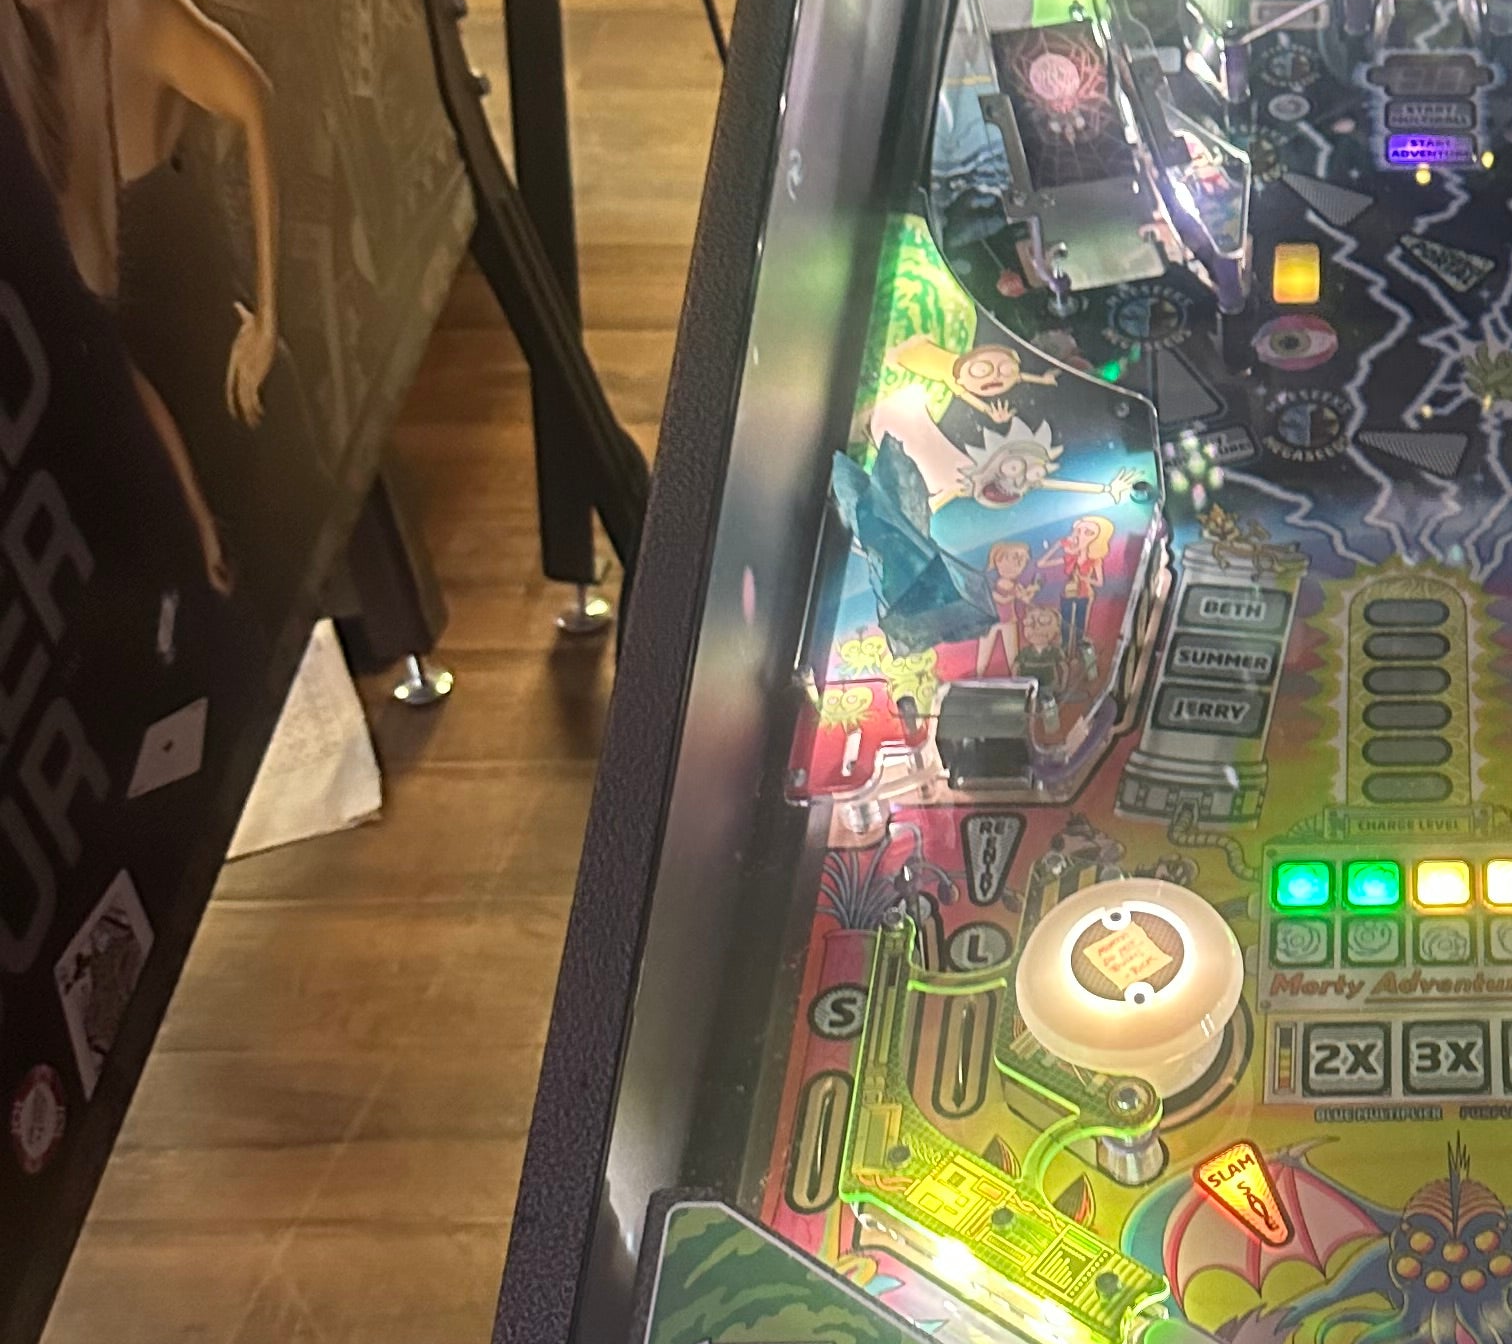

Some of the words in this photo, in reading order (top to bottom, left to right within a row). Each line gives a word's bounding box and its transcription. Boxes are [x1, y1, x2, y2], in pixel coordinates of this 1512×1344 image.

[1202, 598, 1263, 618] BETH
[1178, 648, 1270, 671] SUMMER
[1173, 698, 1245, 721] JERRY
[967, 936, 989, 962] L
[1270, 972, 1365, 999] Morty
[828, 996, 857, 1028] S
[1313, 1040, 1382, 1075] 2X
[1415, 1040, 1479, 1074] 3X
[1207, 1153, 1256, 1188] SLAM
